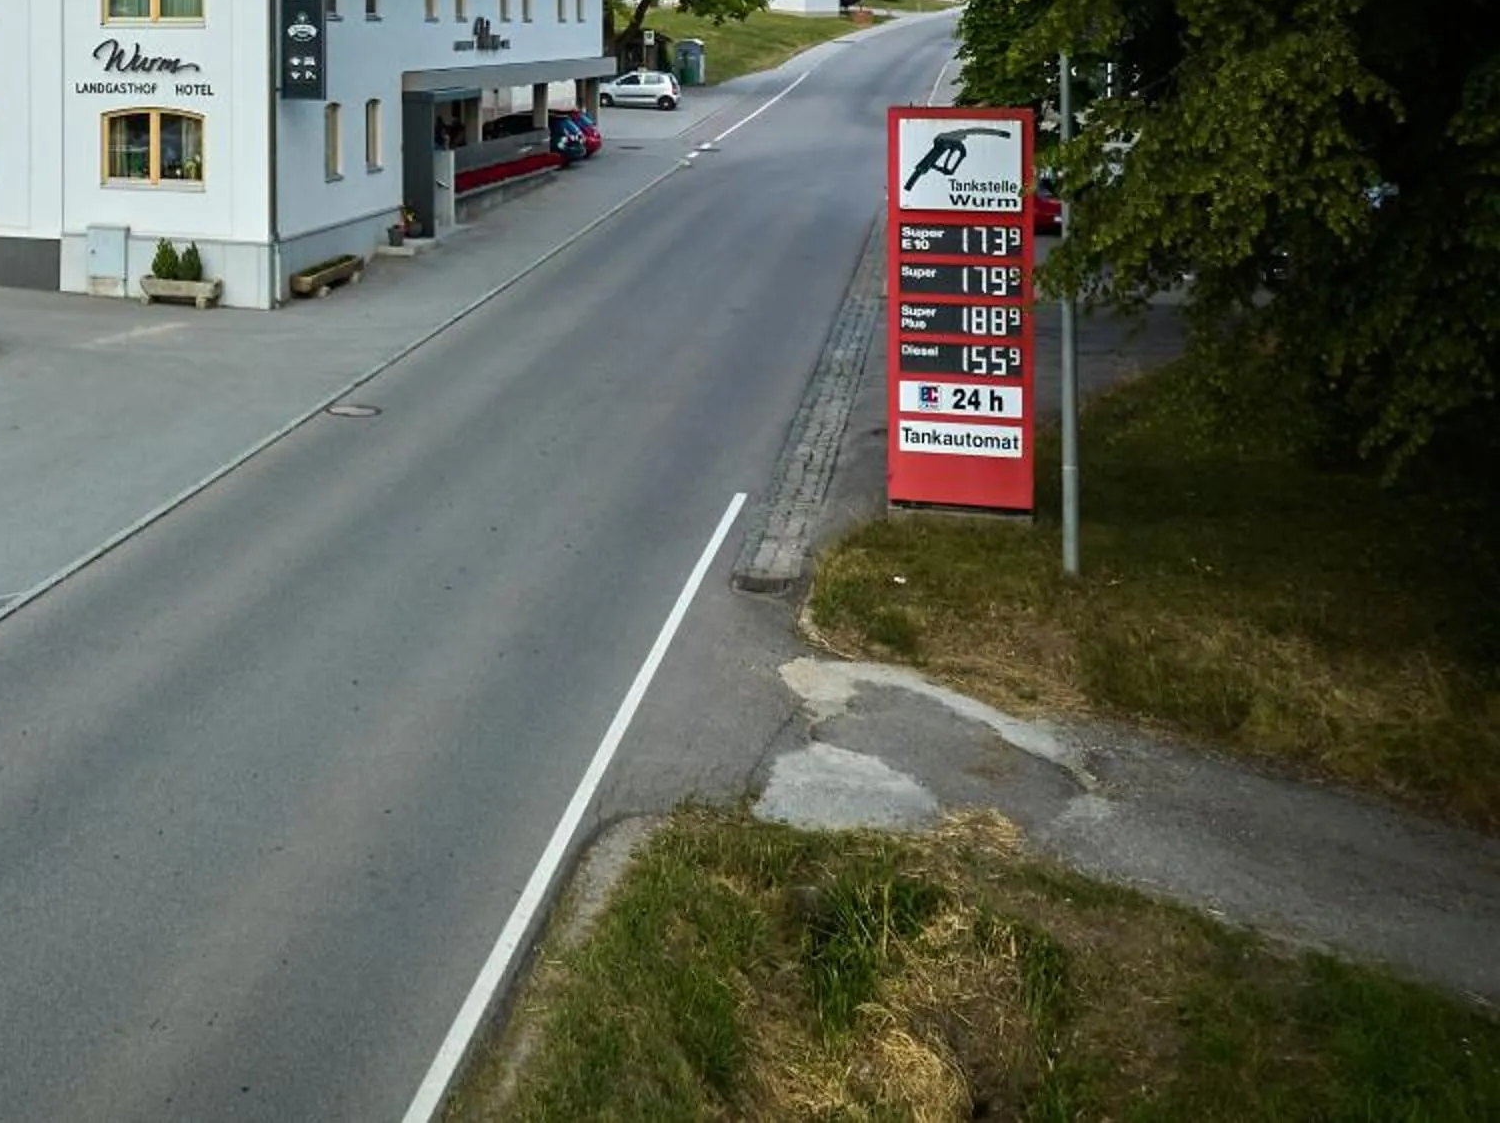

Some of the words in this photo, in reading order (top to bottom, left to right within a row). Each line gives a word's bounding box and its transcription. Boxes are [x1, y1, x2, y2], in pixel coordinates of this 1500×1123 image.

[92, 38, 200, 74] Wurm
[75, 82, 158, 95] LANDGASTHOF
[175, 84, 215, 97] HOTEL
[949, 179, 1019, 194] Tankstelle
[949, 194, 1019, 209] Wurm
[901, 226, 946, 240] Super
[901, 265, 937, 279] Super
[901, 304, 937, 318] Super
[901, 317, 927, 329] Plus
[901, 344, 939, 357] Diesel
[952, 388, 981, 411] 24
[988, 389, 1004, 412] h
[902, 426, 1019, 450] Tankautomat
